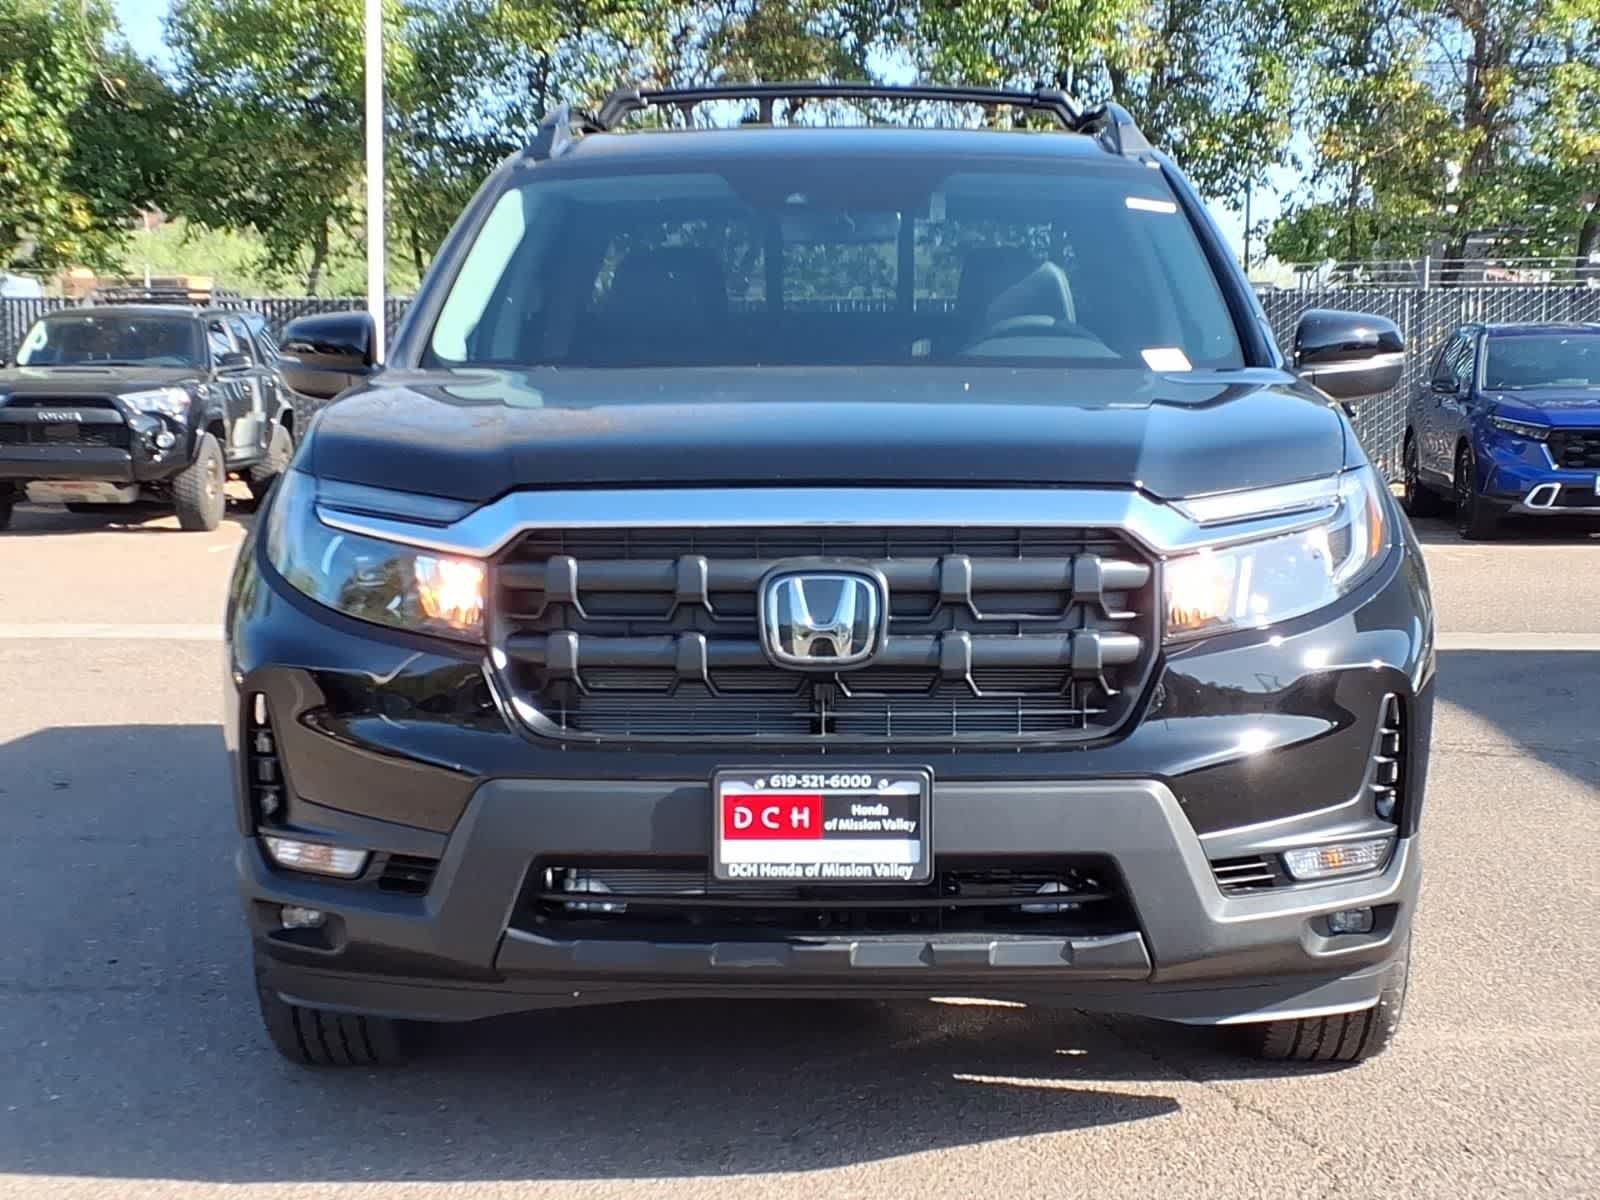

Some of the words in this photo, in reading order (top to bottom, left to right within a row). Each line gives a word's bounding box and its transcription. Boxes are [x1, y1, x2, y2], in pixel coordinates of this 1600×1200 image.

[770, 775, 871, 788] 619-521-6000
[851, 804, 889, 816] Honda
[824, 820, 837, 830] of
[839, 820, 881, 830] Mission
[882, 820, 916, 832] Valley
[728, 864, 757, 876] DCH
[761, 864, 804, 876] Honda
[805, 864, 819, 876] of
[822, 864, 872, 876] Mission
[875, 864, 913, 879] Valley
